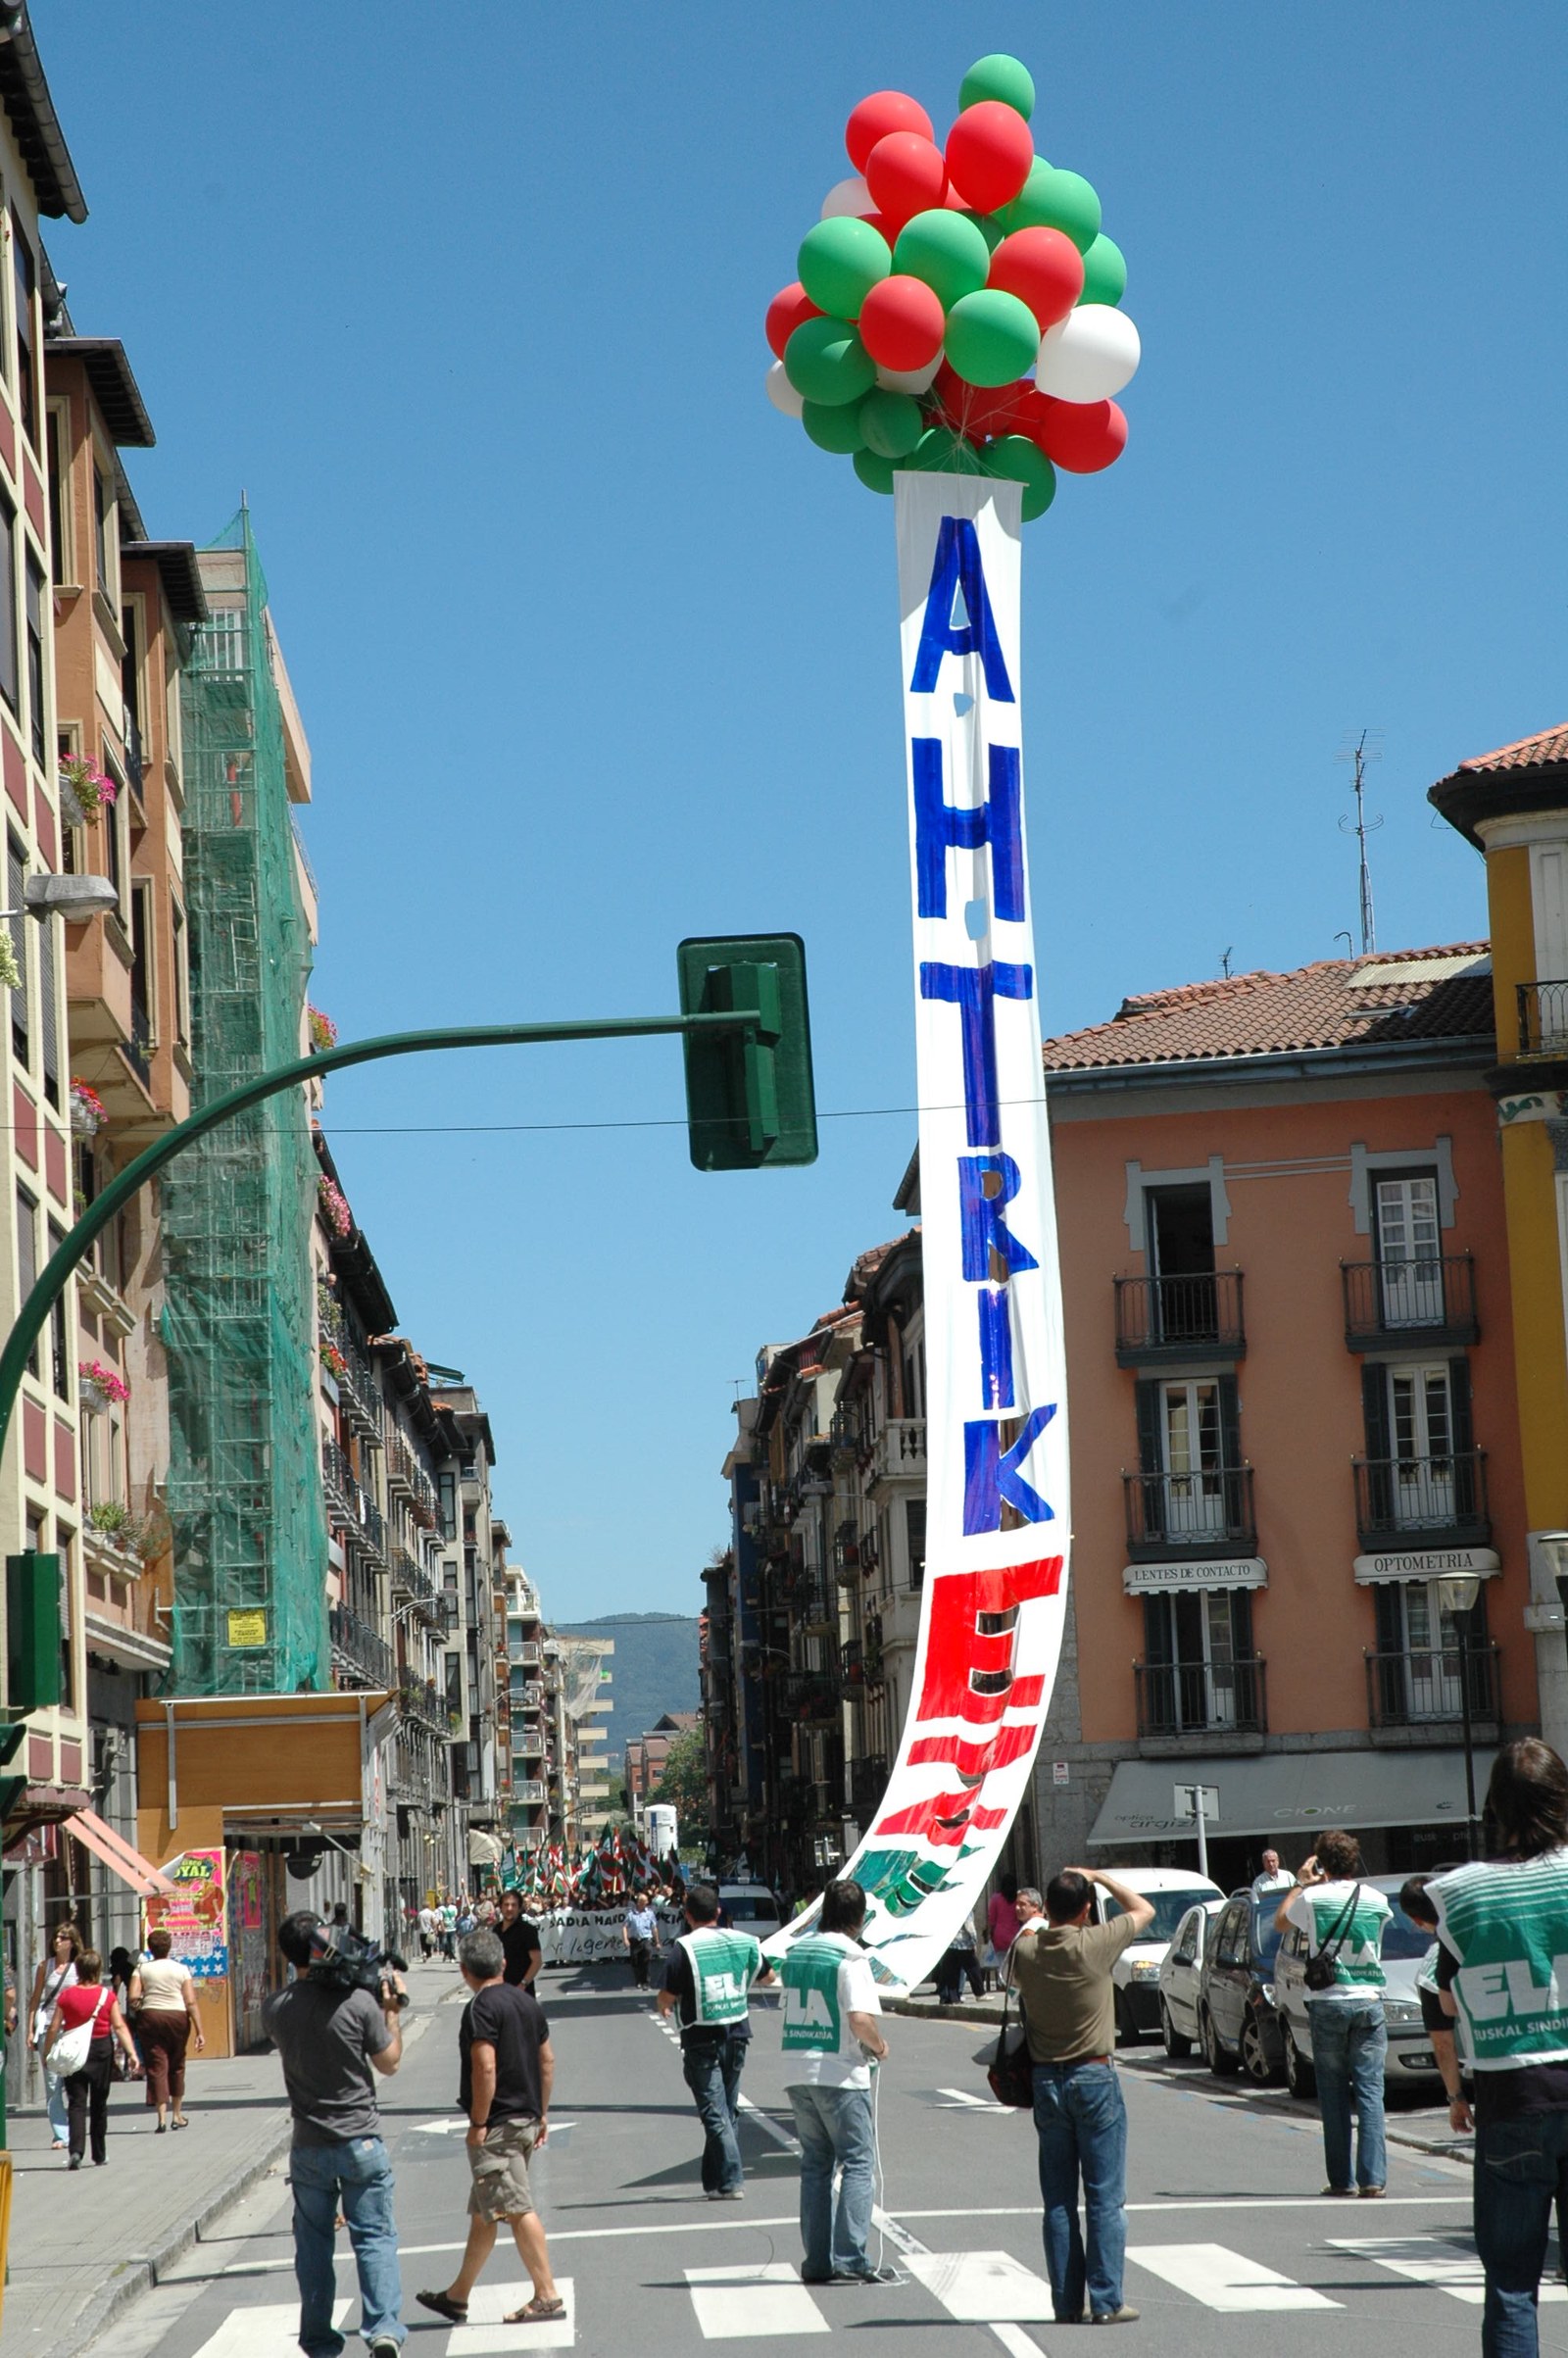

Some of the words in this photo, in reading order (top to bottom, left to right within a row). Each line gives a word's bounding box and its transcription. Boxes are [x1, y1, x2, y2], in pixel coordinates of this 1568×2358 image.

[910, 515, 1057, 1536] AHTRIK
[1374, 1553, 1474, 1572] OPTOMETRIA
[1135, 1568, 1177, 1581] LENTES
[1180, 1568, 1194, 1579] DE
[1197, 1564, 1250, 1578] CONTACTO
[874, 1555, 1063, 1846] EZ
[1274, 1804, 1357, 1818] CIONE
[1527, 2016, 1568, 2035] SINDI
